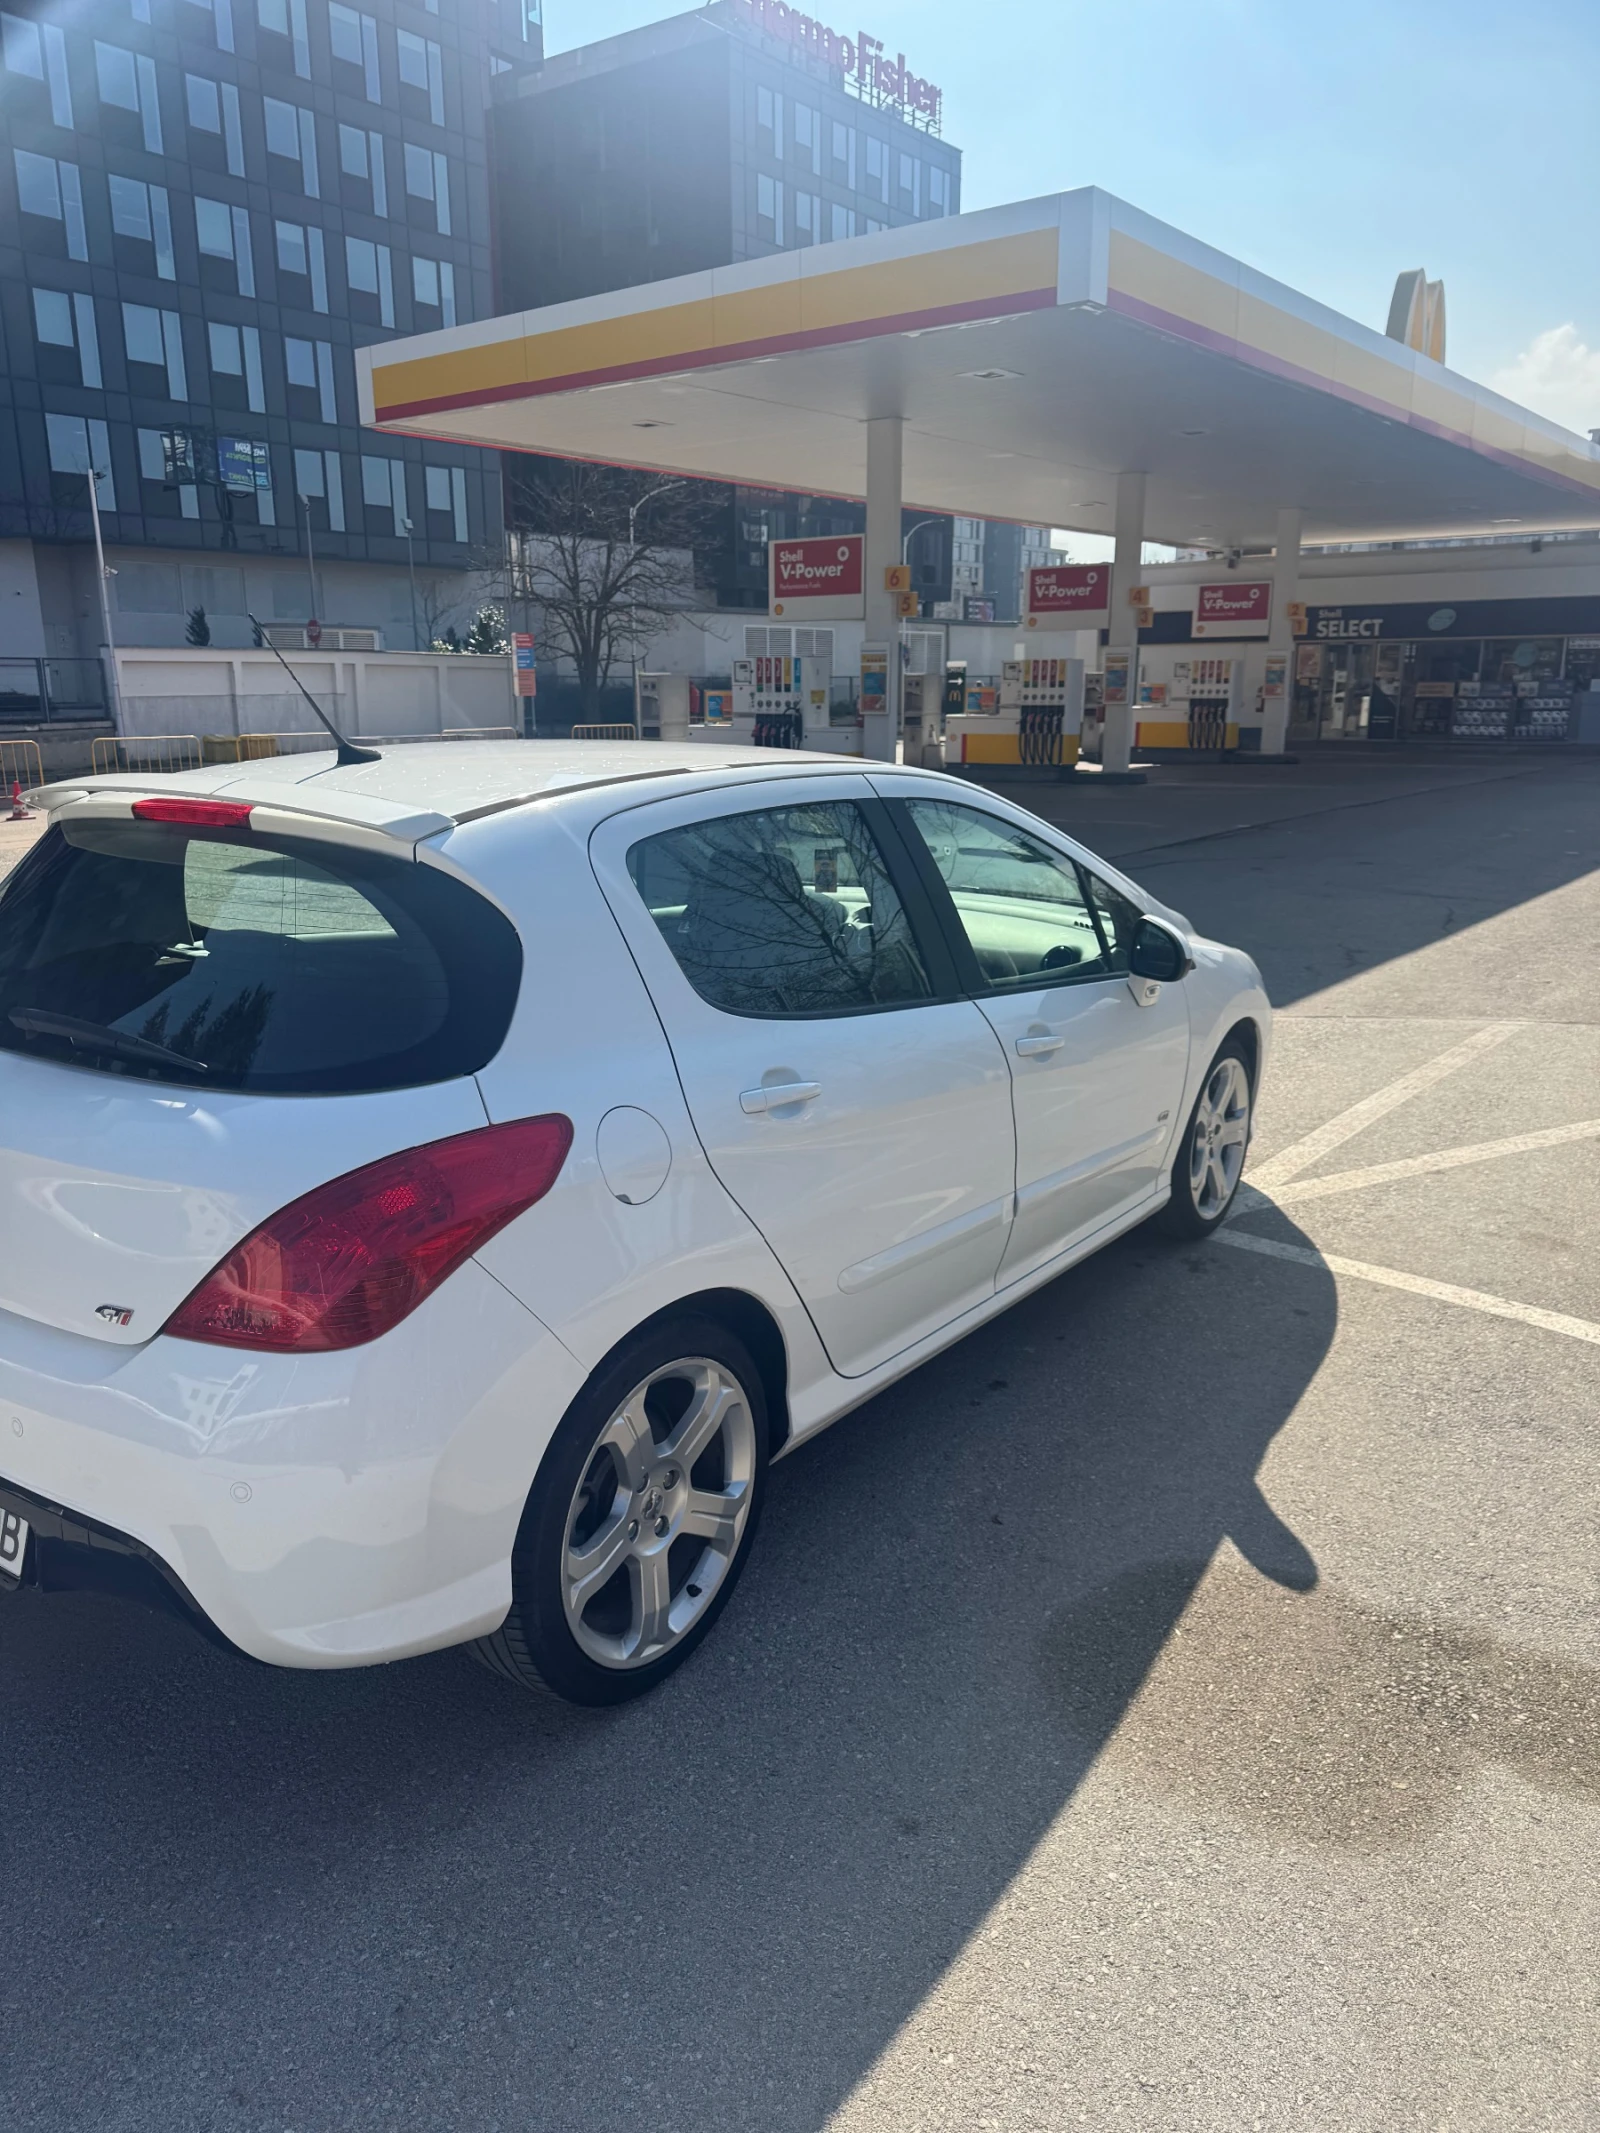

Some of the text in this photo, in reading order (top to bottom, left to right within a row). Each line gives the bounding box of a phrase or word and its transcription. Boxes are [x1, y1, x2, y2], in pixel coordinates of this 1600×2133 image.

[780, 549, 804, 563] Shell
[780, 563, 844, 580] V-Power
[890, 568, 900, 587] 6
[1034, 573, 1056, 585] Shell
[1035, 585, 1093, 598] V-Power
[1132, 590, 1142, 604] 4
[901, 596, 911, 612] 5
[1203, 599, 1256, 610] V-Power
[1291, 603, 1300, 615] 2
[1140, 610, 1149, 624] 3
[1318, 608, 1343, 619] Shell
[1316, 619, 1384, 638] SELECT
